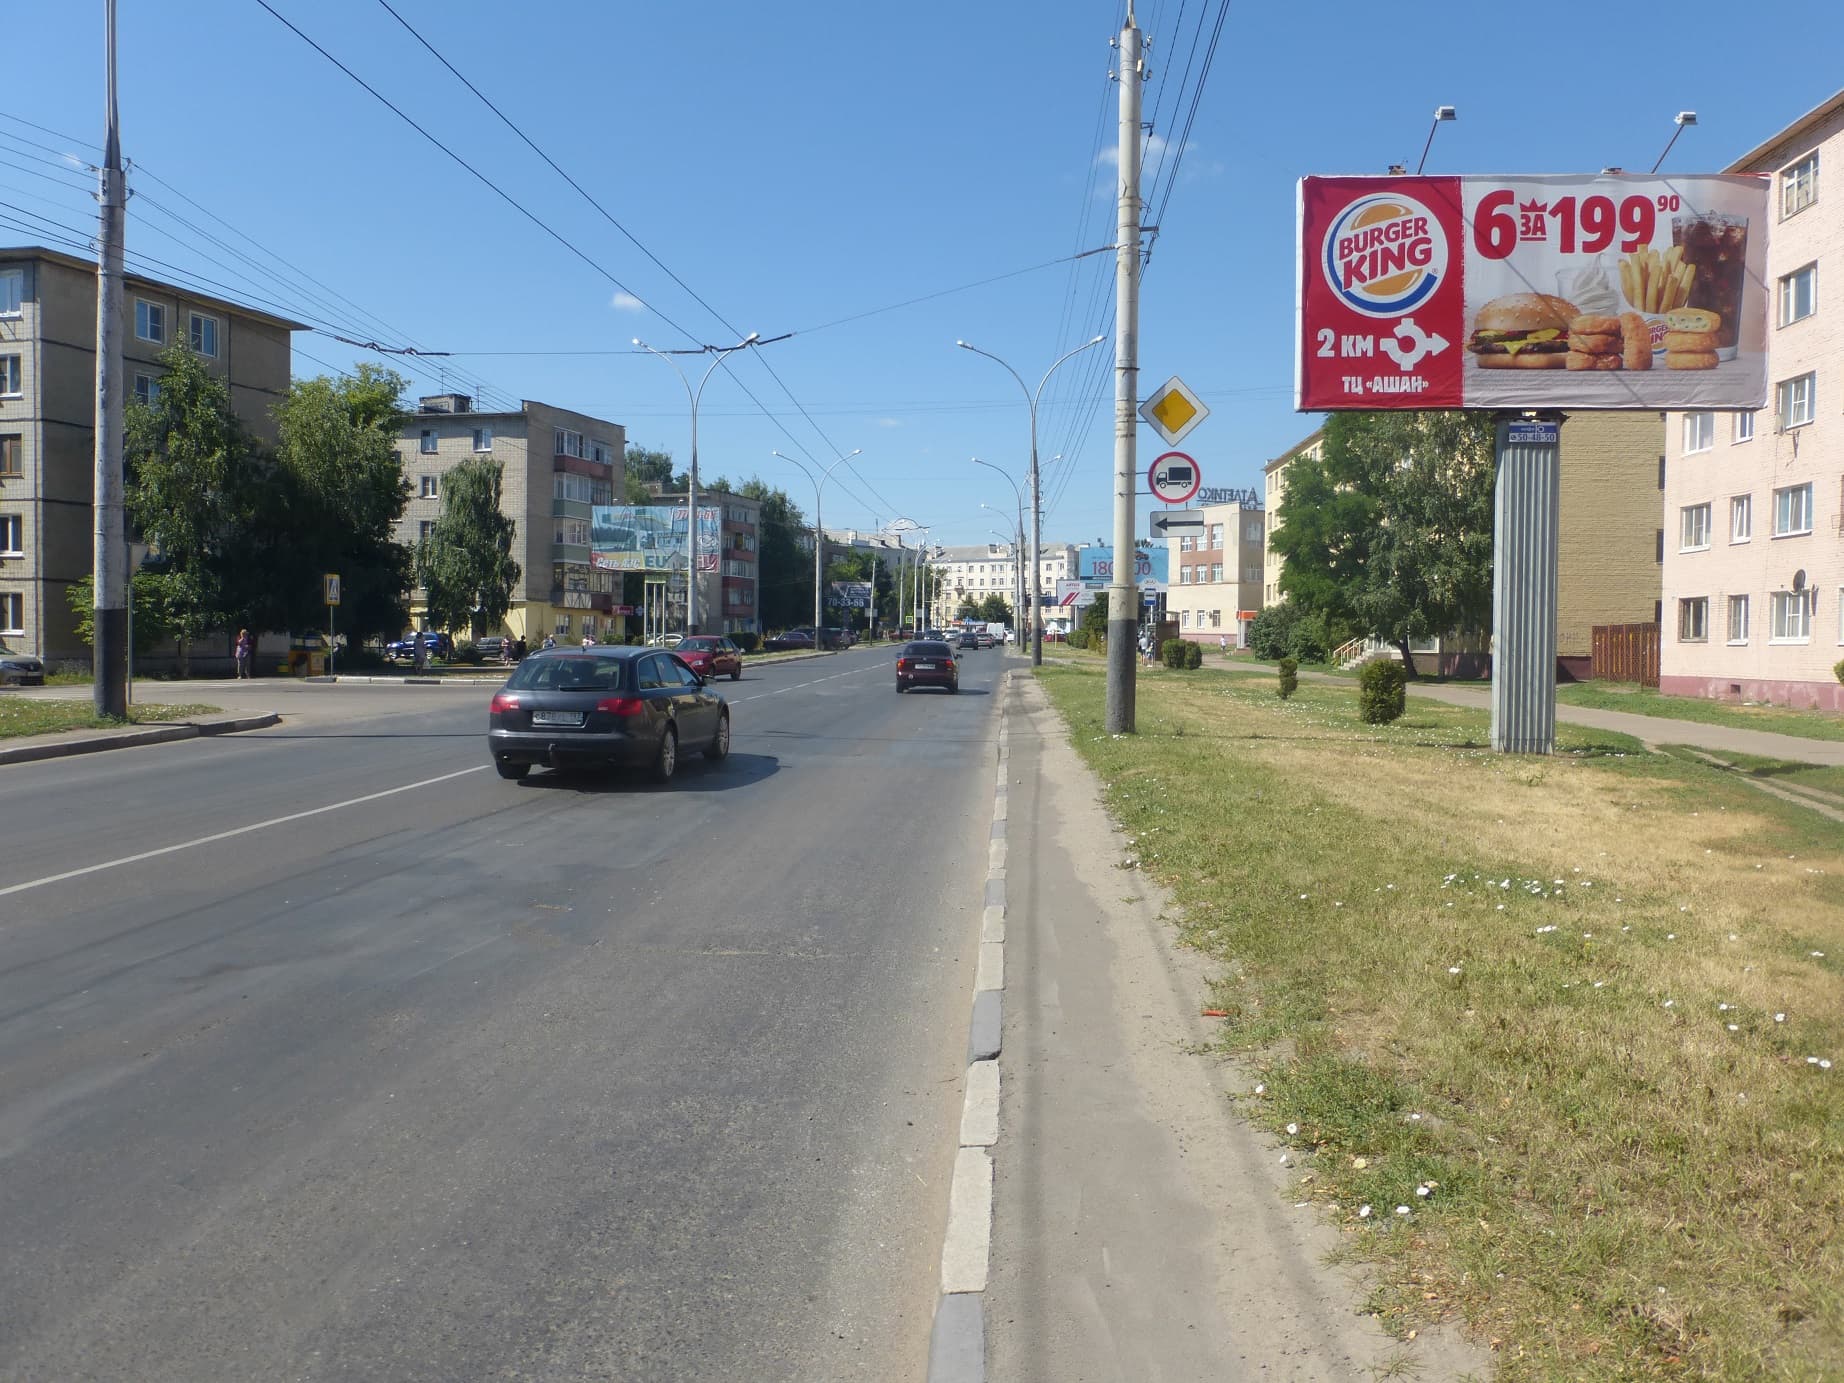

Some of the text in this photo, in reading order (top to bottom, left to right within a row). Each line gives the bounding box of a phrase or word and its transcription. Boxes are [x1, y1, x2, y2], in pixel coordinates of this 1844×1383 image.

[1339, 216, 1429, 261] BURGER
[1473, 189, 1680, 260] 6 ЗА 199 90
[1343, 236, 1432, 291] KING
[1317, 328, 1374, 358] 2 КМ
[1341, 376, 1429, 395] ТЦ «АШАН»
